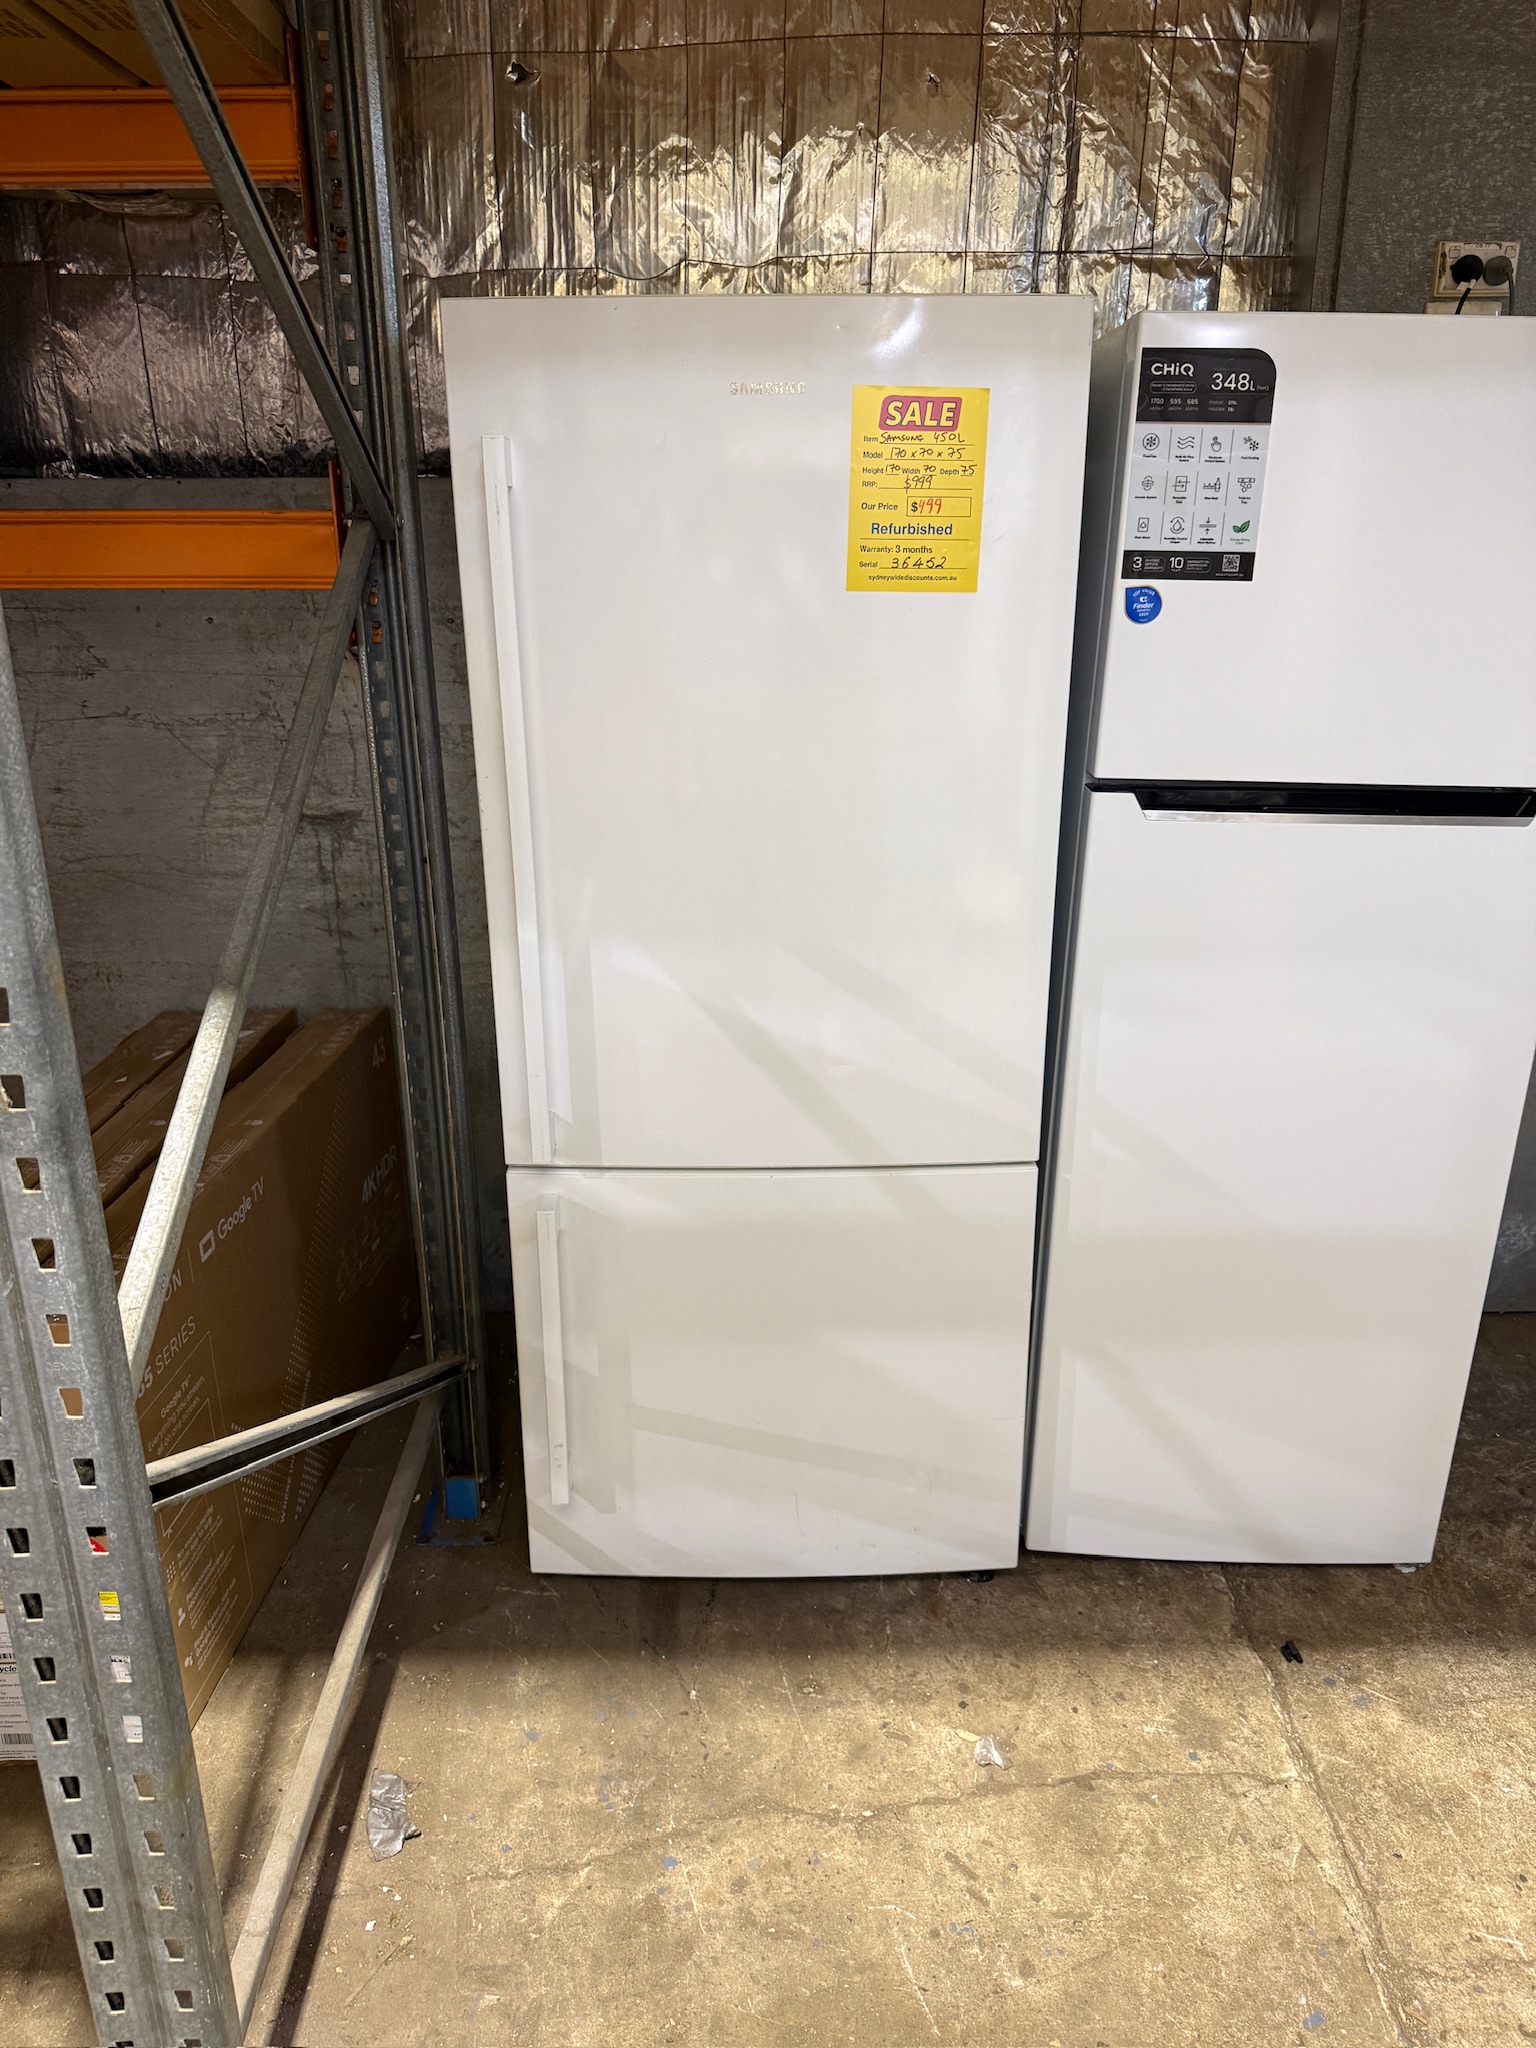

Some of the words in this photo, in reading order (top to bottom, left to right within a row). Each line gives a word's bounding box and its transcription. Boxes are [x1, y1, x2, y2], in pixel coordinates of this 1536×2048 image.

[1150, 362, 1195, 377] CHiQ
[729, 382, 806, 395] SAMSUNG
[885, 400, 957, 427] SALE
[880, 432, 924, 444] SAMSUNG
[933, 432, 965, 443] 450L
[863, 451, 883, 459] Model
[890, 447, 907, 460] 170
[919, 447, 933, 458] 70
[947, 447, 966, 459] 75
[862, 467, 884, 475] Height
[885, 463, 900, 473] 170
[902, 467, 920, 475] Width
[923, 464, 937, 473] 70
[939, 468, 959, 476] Depth
[960, 464, 978, 475] 75
[904, 475, 933, 494] $999
[861, 502, 876, 510] Our
[878, 502, 898, 510] Price
[871, 522, 953, 535] Refurbished
[859, 545, 893, 554] Warranty:
[895, 545, 901, 553] 3
[902, 546, 933, 554] months
[1132, 556, 1143, 569] 3
[1169, 556, 1184, 569] 10
[217, 1195, 253, 1240] Google
[251, 1175, 264, 1202] TV
[155, 1315, 196, 1374] SERIES
